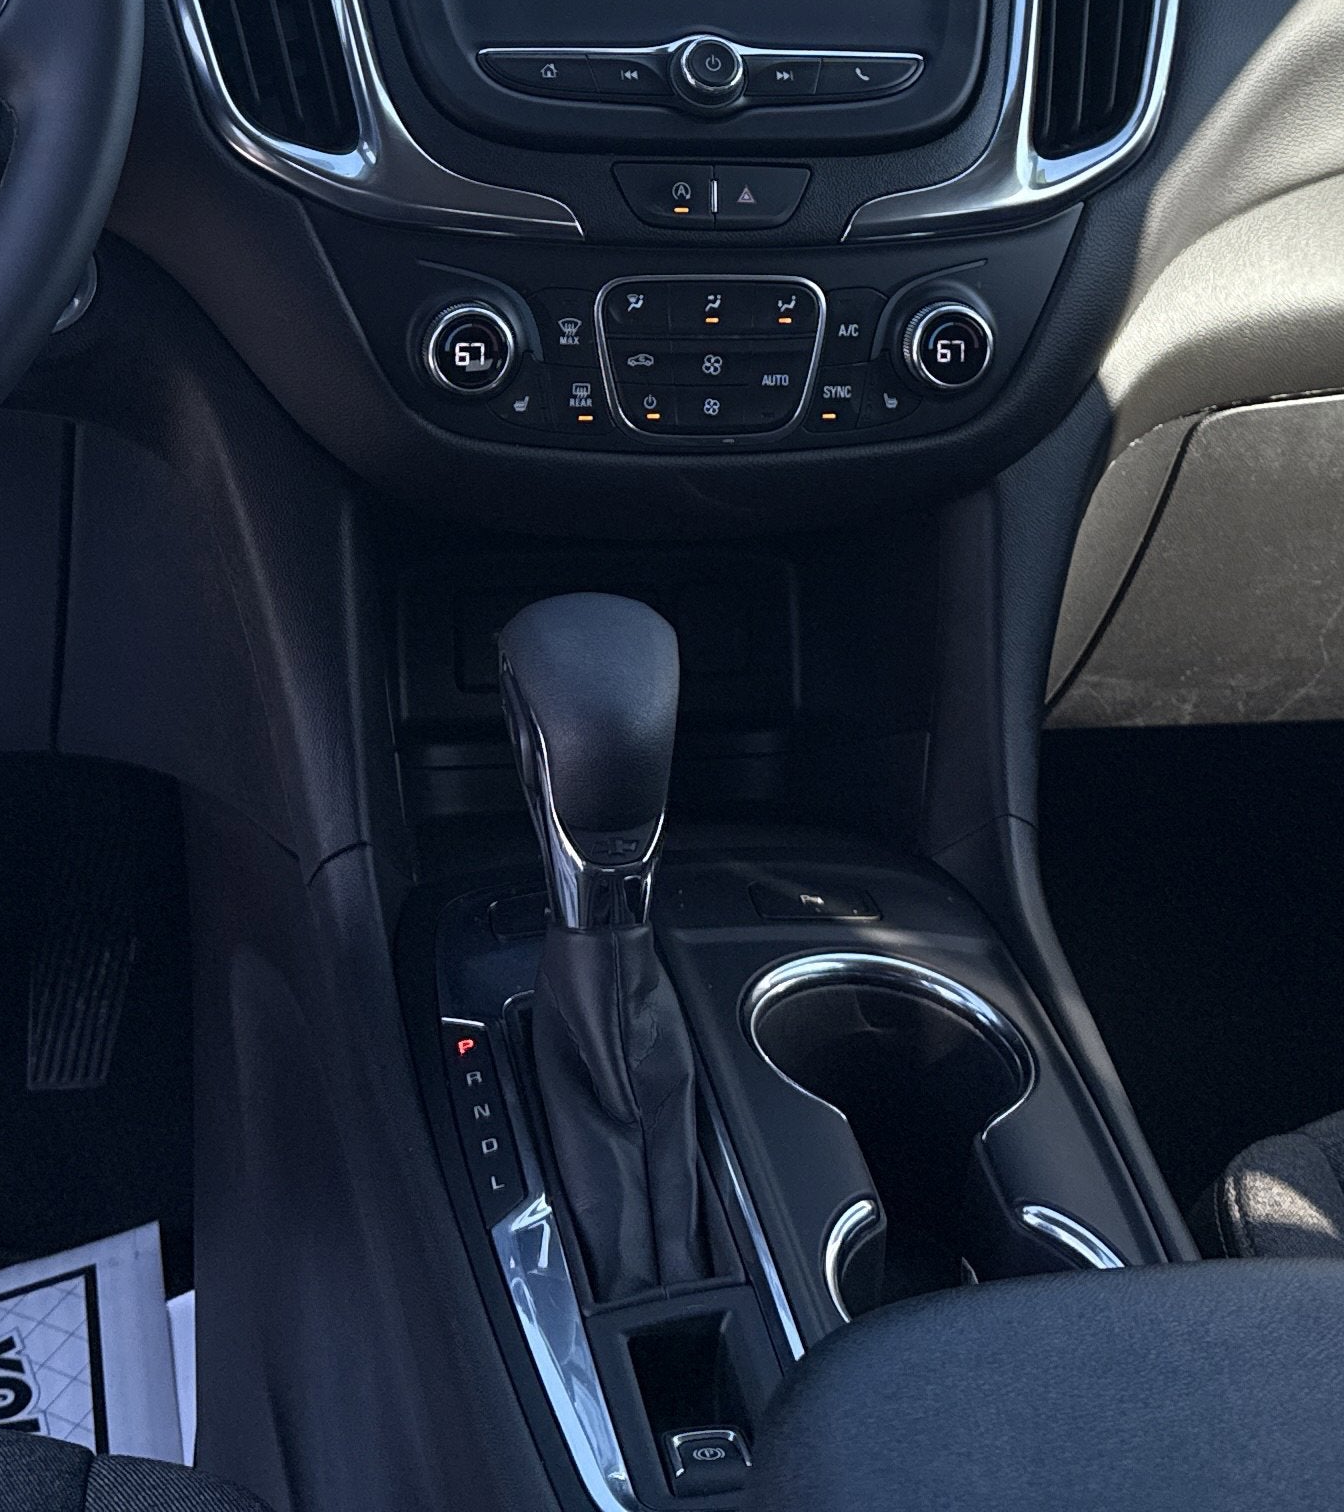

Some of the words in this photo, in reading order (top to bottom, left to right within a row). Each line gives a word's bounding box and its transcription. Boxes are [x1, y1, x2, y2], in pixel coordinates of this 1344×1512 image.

[838, 324, 859, 337] A/C
[559, 336, 580, 345] MAX
[455, 342, 485, 366] 67
[936, 340, 965, 363] 67
[761, 374, 790, 386] AUTO
[823, 386, 852, 399] SYNC
[569, 398, 593, 407] REAR
[457, 1038, 476, 1056] P
[466, 1071, 483, 1087] R
[473, 1103, 491, 1120] N
[481, 1138, 498, 1155] D
[491, 1176, 505, 1190] L
